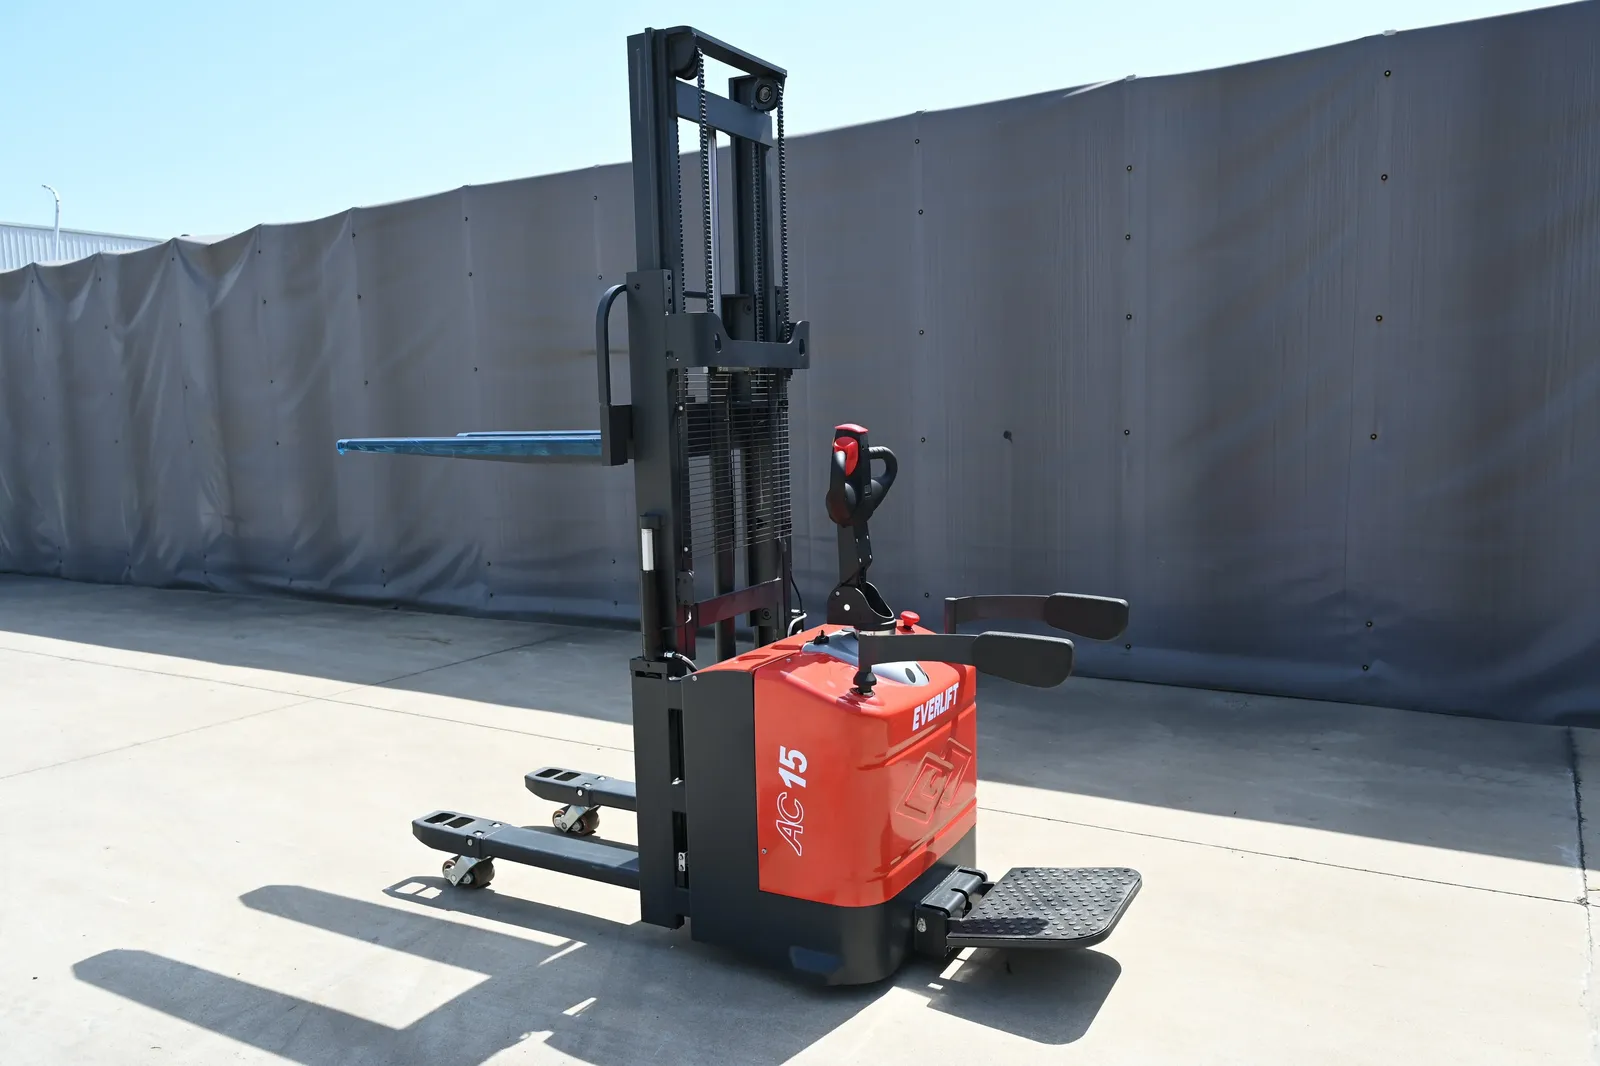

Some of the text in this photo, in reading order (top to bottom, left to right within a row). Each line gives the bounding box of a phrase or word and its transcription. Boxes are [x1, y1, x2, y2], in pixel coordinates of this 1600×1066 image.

[912, 683, 959, 731] EVERLIFT
[776, 745, 808, 856] AC 15
